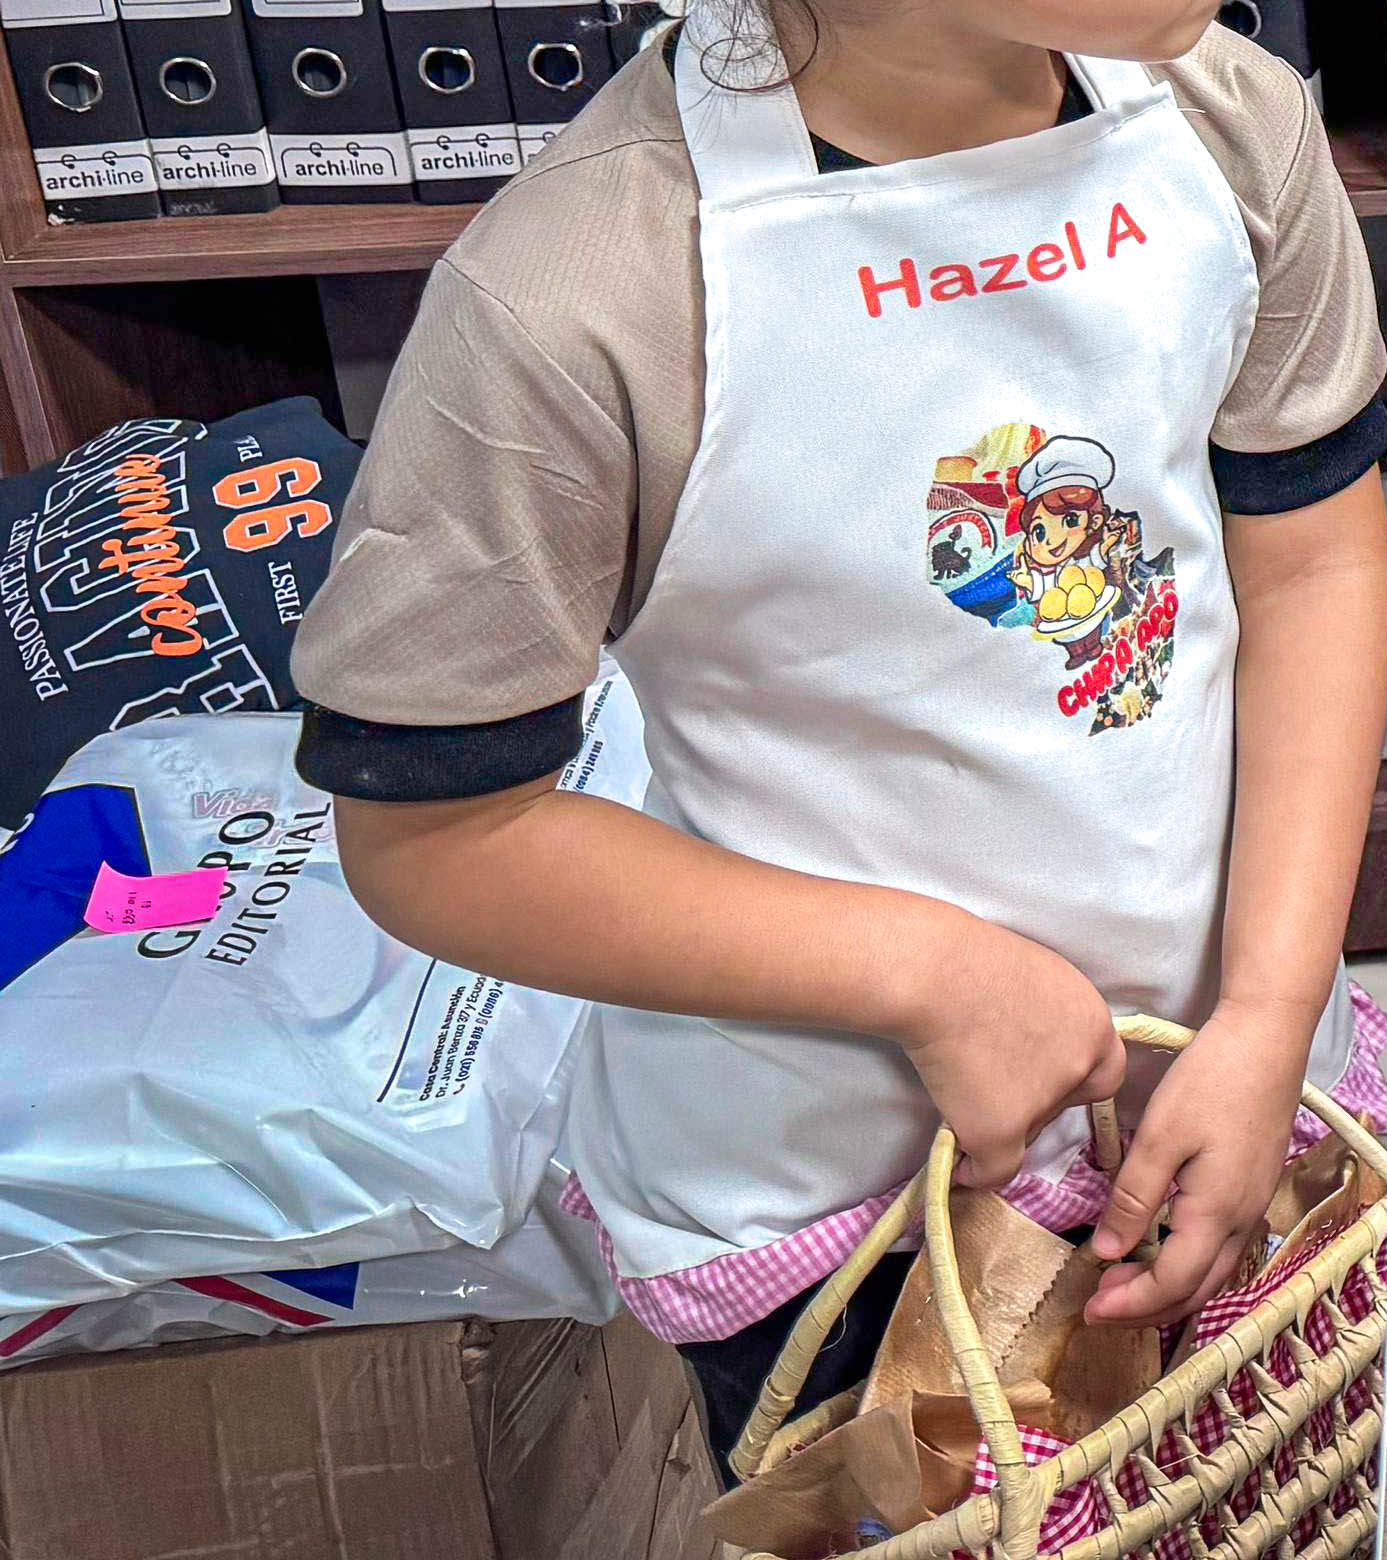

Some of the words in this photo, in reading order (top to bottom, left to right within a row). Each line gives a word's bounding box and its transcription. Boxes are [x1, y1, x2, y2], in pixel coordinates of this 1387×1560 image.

[857, 221, 1087, 319] Hazel
[1107, 202, 1148, 259] A
[98, 453, 203, 657] continue
[212, 457, 334, 553] 99
[0, 554, 70, 702] PASSIONATE
[268, 561, 303, 624] FIRST
[1056, 636, 1135, 718] CHIPA
[1135, 589, 1180, 655] APO
[137, 810, 276, 959] GPO
[205, 802, 331, 967] EDITORIAL
